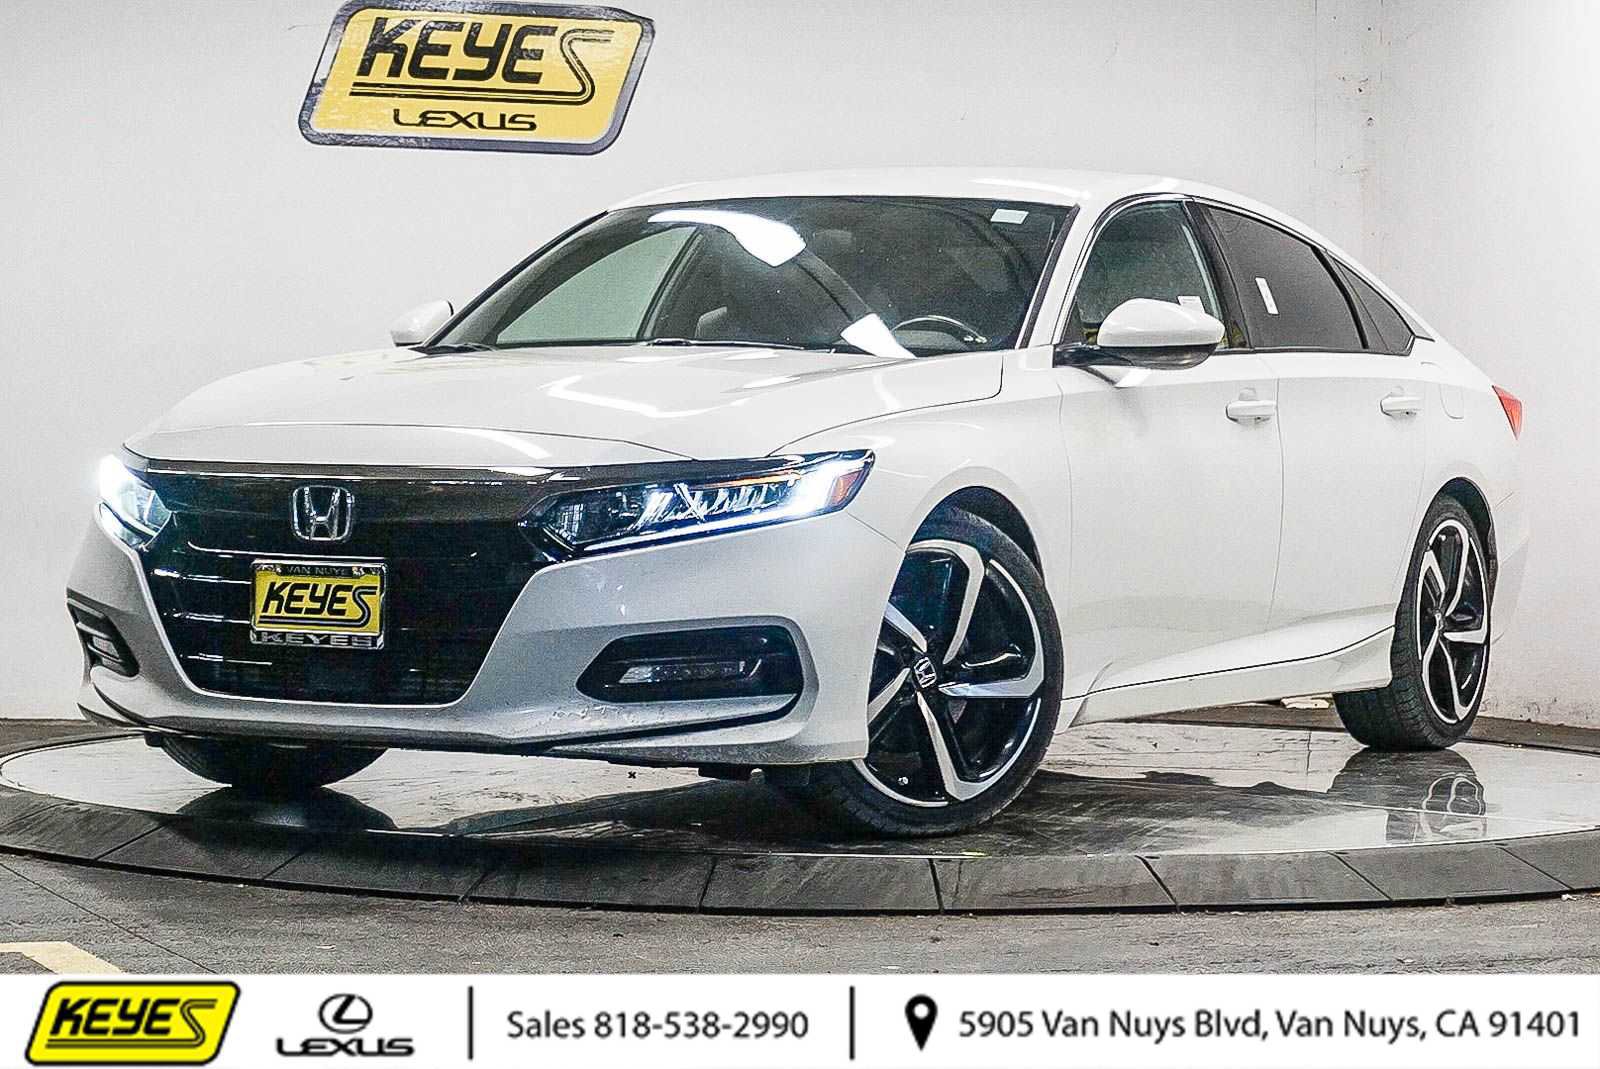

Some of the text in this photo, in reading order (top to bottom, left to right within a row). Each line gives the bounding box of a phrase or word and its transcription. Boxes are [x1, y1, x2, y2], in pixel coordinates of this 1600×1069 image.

[349, 16, 615, 106] KEYES
[393, 108, 537, 131] LEXUS
[287, 566, 312, 575] VAN
[256, 581, 378, 628] KEYES
[261, 631, 373, 648] KEYES
